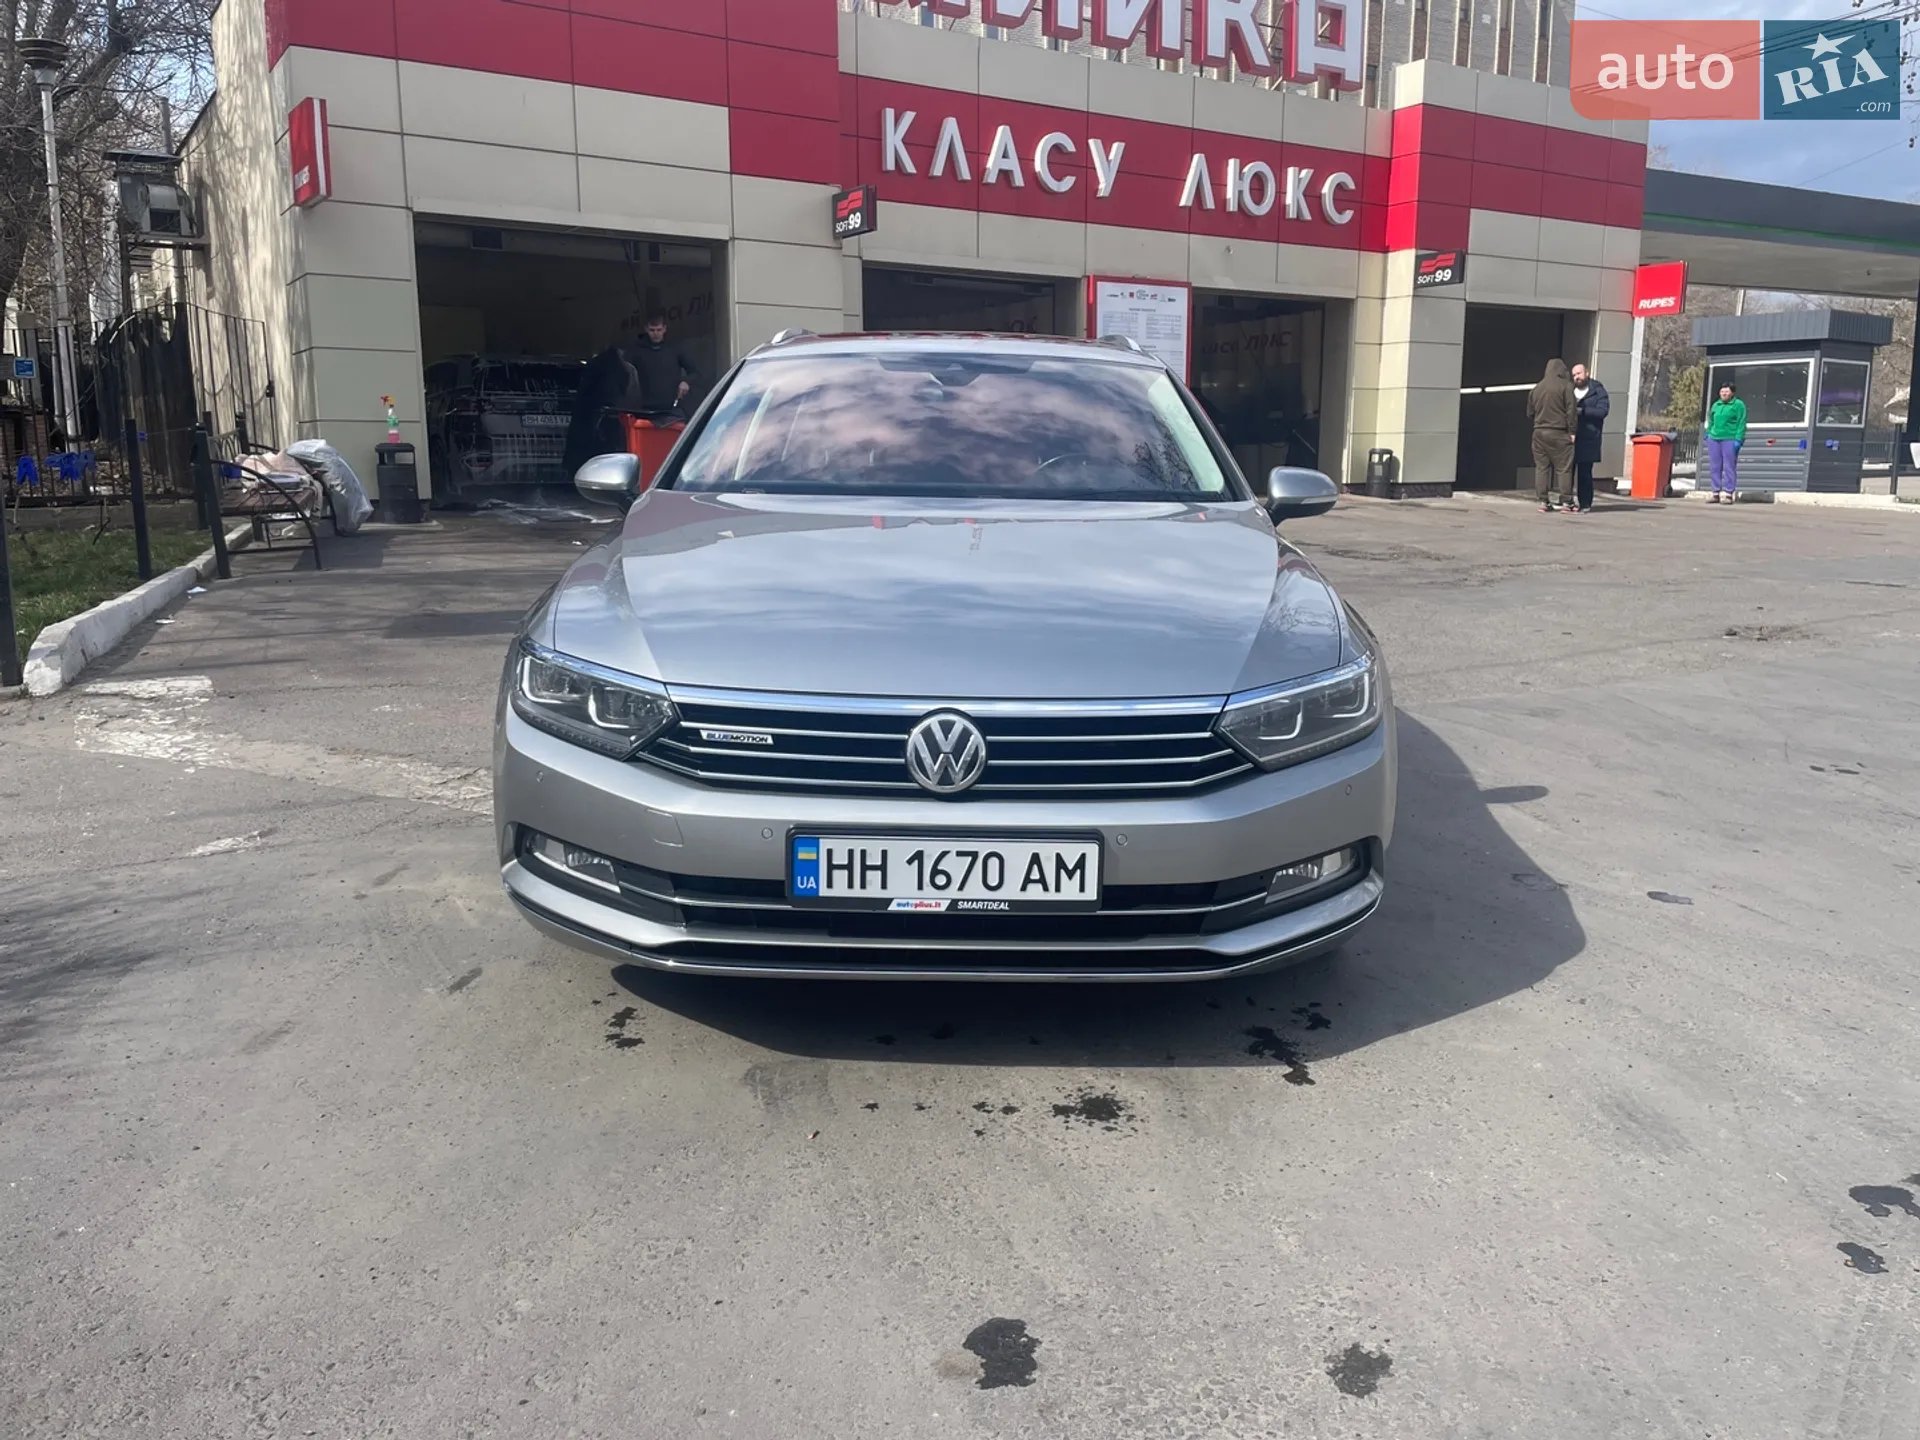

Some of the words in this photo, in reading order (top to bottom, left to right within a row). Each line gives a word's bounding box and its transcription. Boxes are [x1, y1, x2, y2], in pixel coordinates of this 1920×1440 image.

[881, 107, 1126, 198] КЛАСУ
[1178, 153, 1356, 225] ЛЮКС
[1638, 296, 1677, 309] RUPES
[706, 732, 769, 744] BLUEMOTION
[826, 848, 888, 890] HH
[906, 850, 1004, 892] 1670
[1019, 852, 1087, 893] AM
[797, 876, 817, 889] UA
[957, 901, 1010, 910] SMARTDEAL
